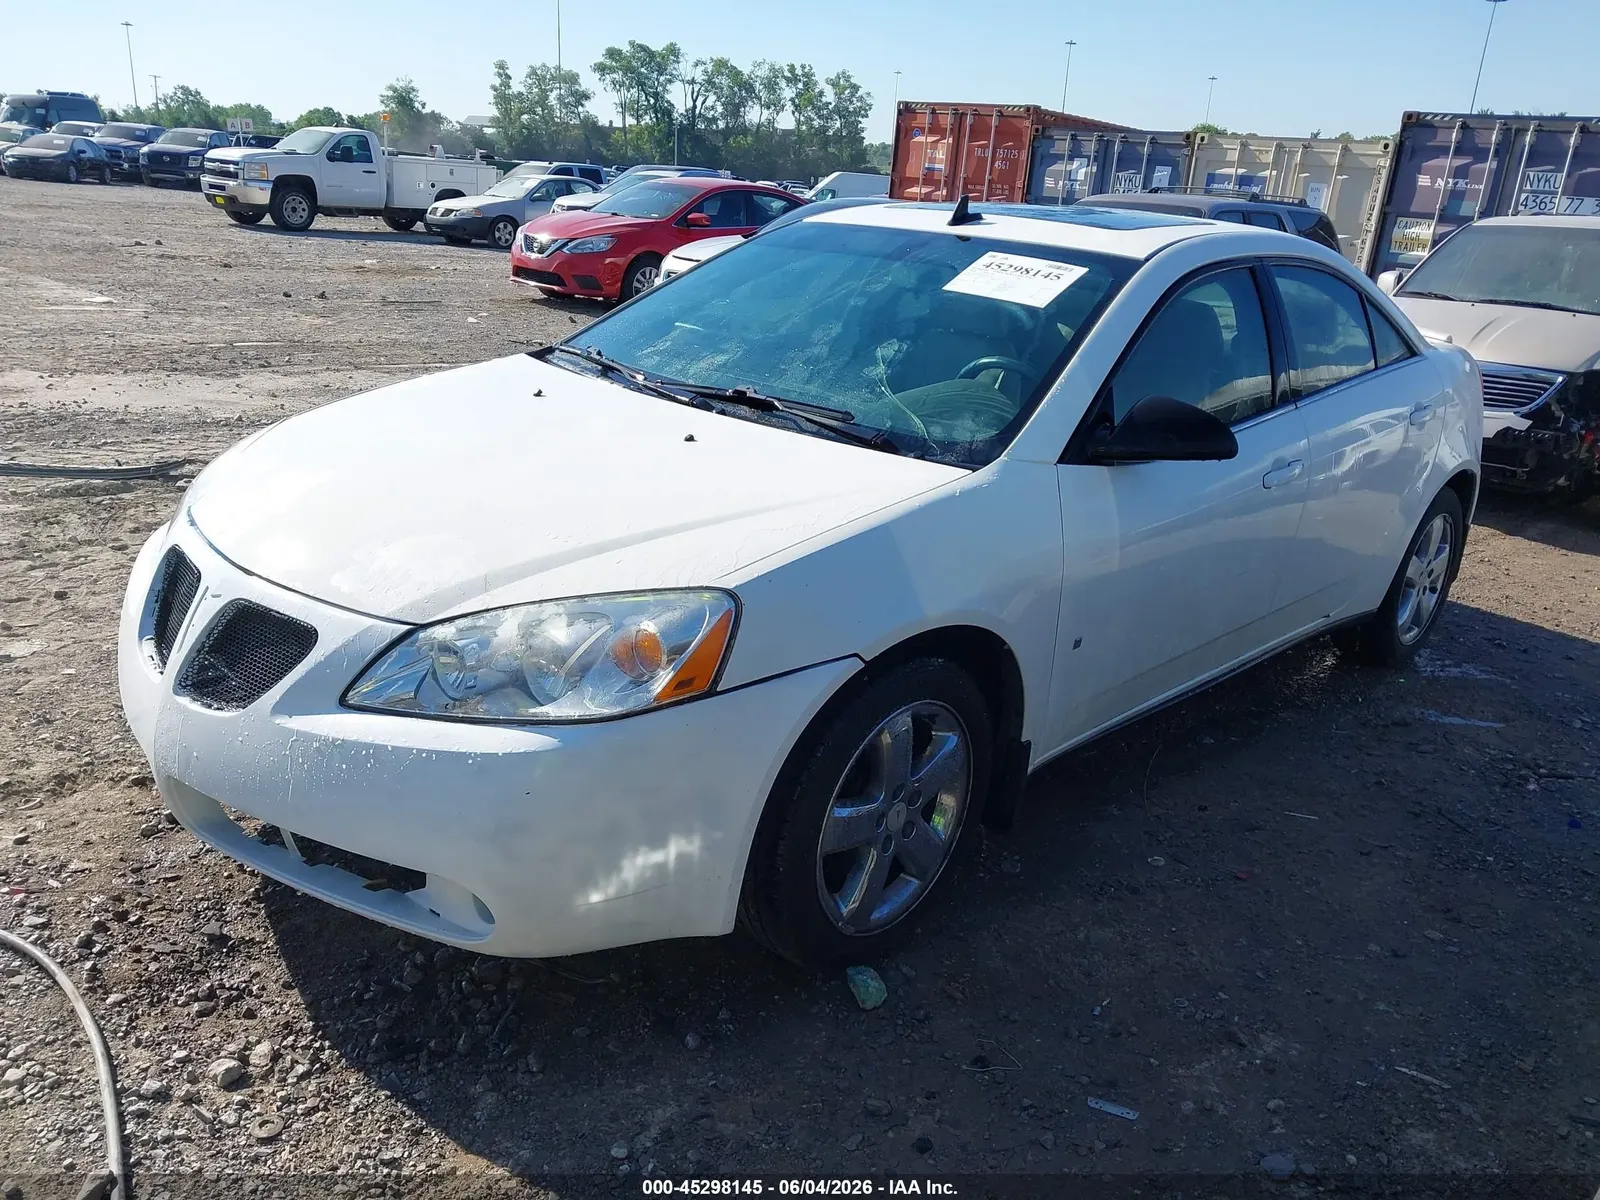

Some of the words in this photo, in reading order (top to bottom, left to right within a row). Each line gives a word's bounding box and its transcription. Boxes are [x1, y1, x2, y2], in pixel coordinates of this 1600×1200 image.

[996, 149, 1019, 159] 757125
[994, 161, 1009, 169] 45G1
[1116, 174, 1141, 188] NYKU
[1434, 178, 1469, 188] NYK
[1525, 173, 1563, 189] NYKU
[1520, 195, 1558, 211] 4365
[1563, 197, 1584, 213] 77
[1398, 220, 1433, 231] CAUTION
[1402, 232, 1420, 241] HIGH
[1394, 241, 1427, 252] TRAILER
[982, 261, 1064, 281] 45298145
